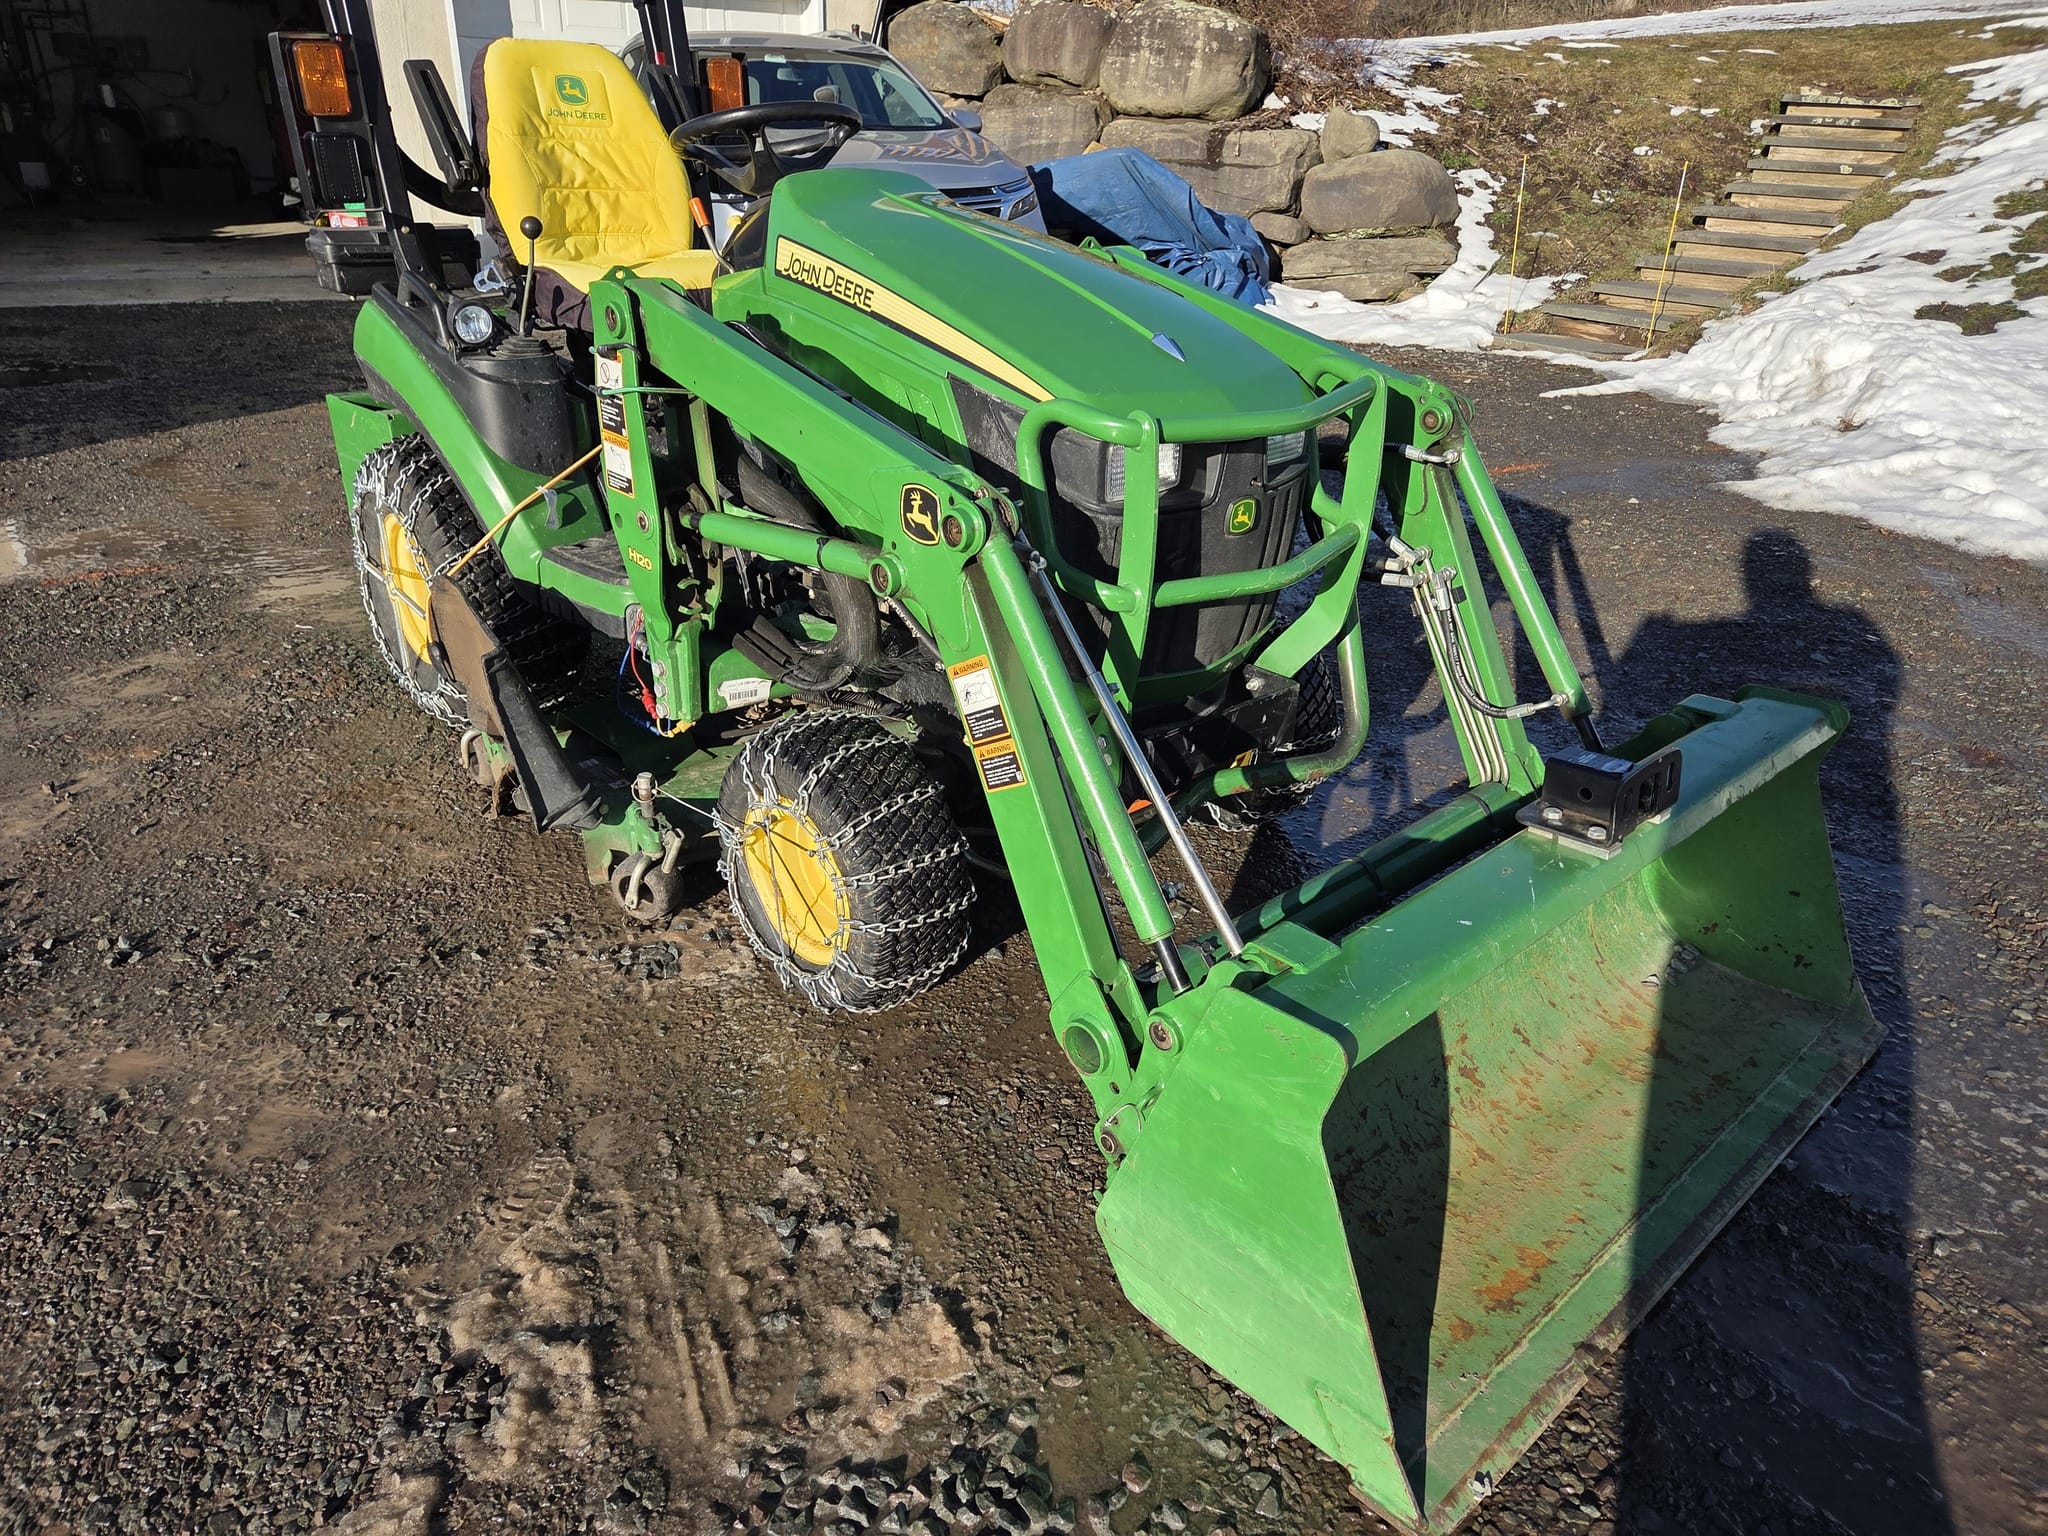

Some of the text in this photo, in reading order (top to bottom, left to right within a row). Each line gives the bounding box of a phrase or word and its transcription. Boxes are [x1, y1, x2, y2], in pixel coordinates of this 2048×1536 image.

[547, 108, 608, 120] JOHN DEERE
[784, 252, 874, 309] JOHN DEERE
[628, 545, 652, 571] H120
[959, 659, 984, 674] WARNING
[986, 743, 1011, 757] WARNING
